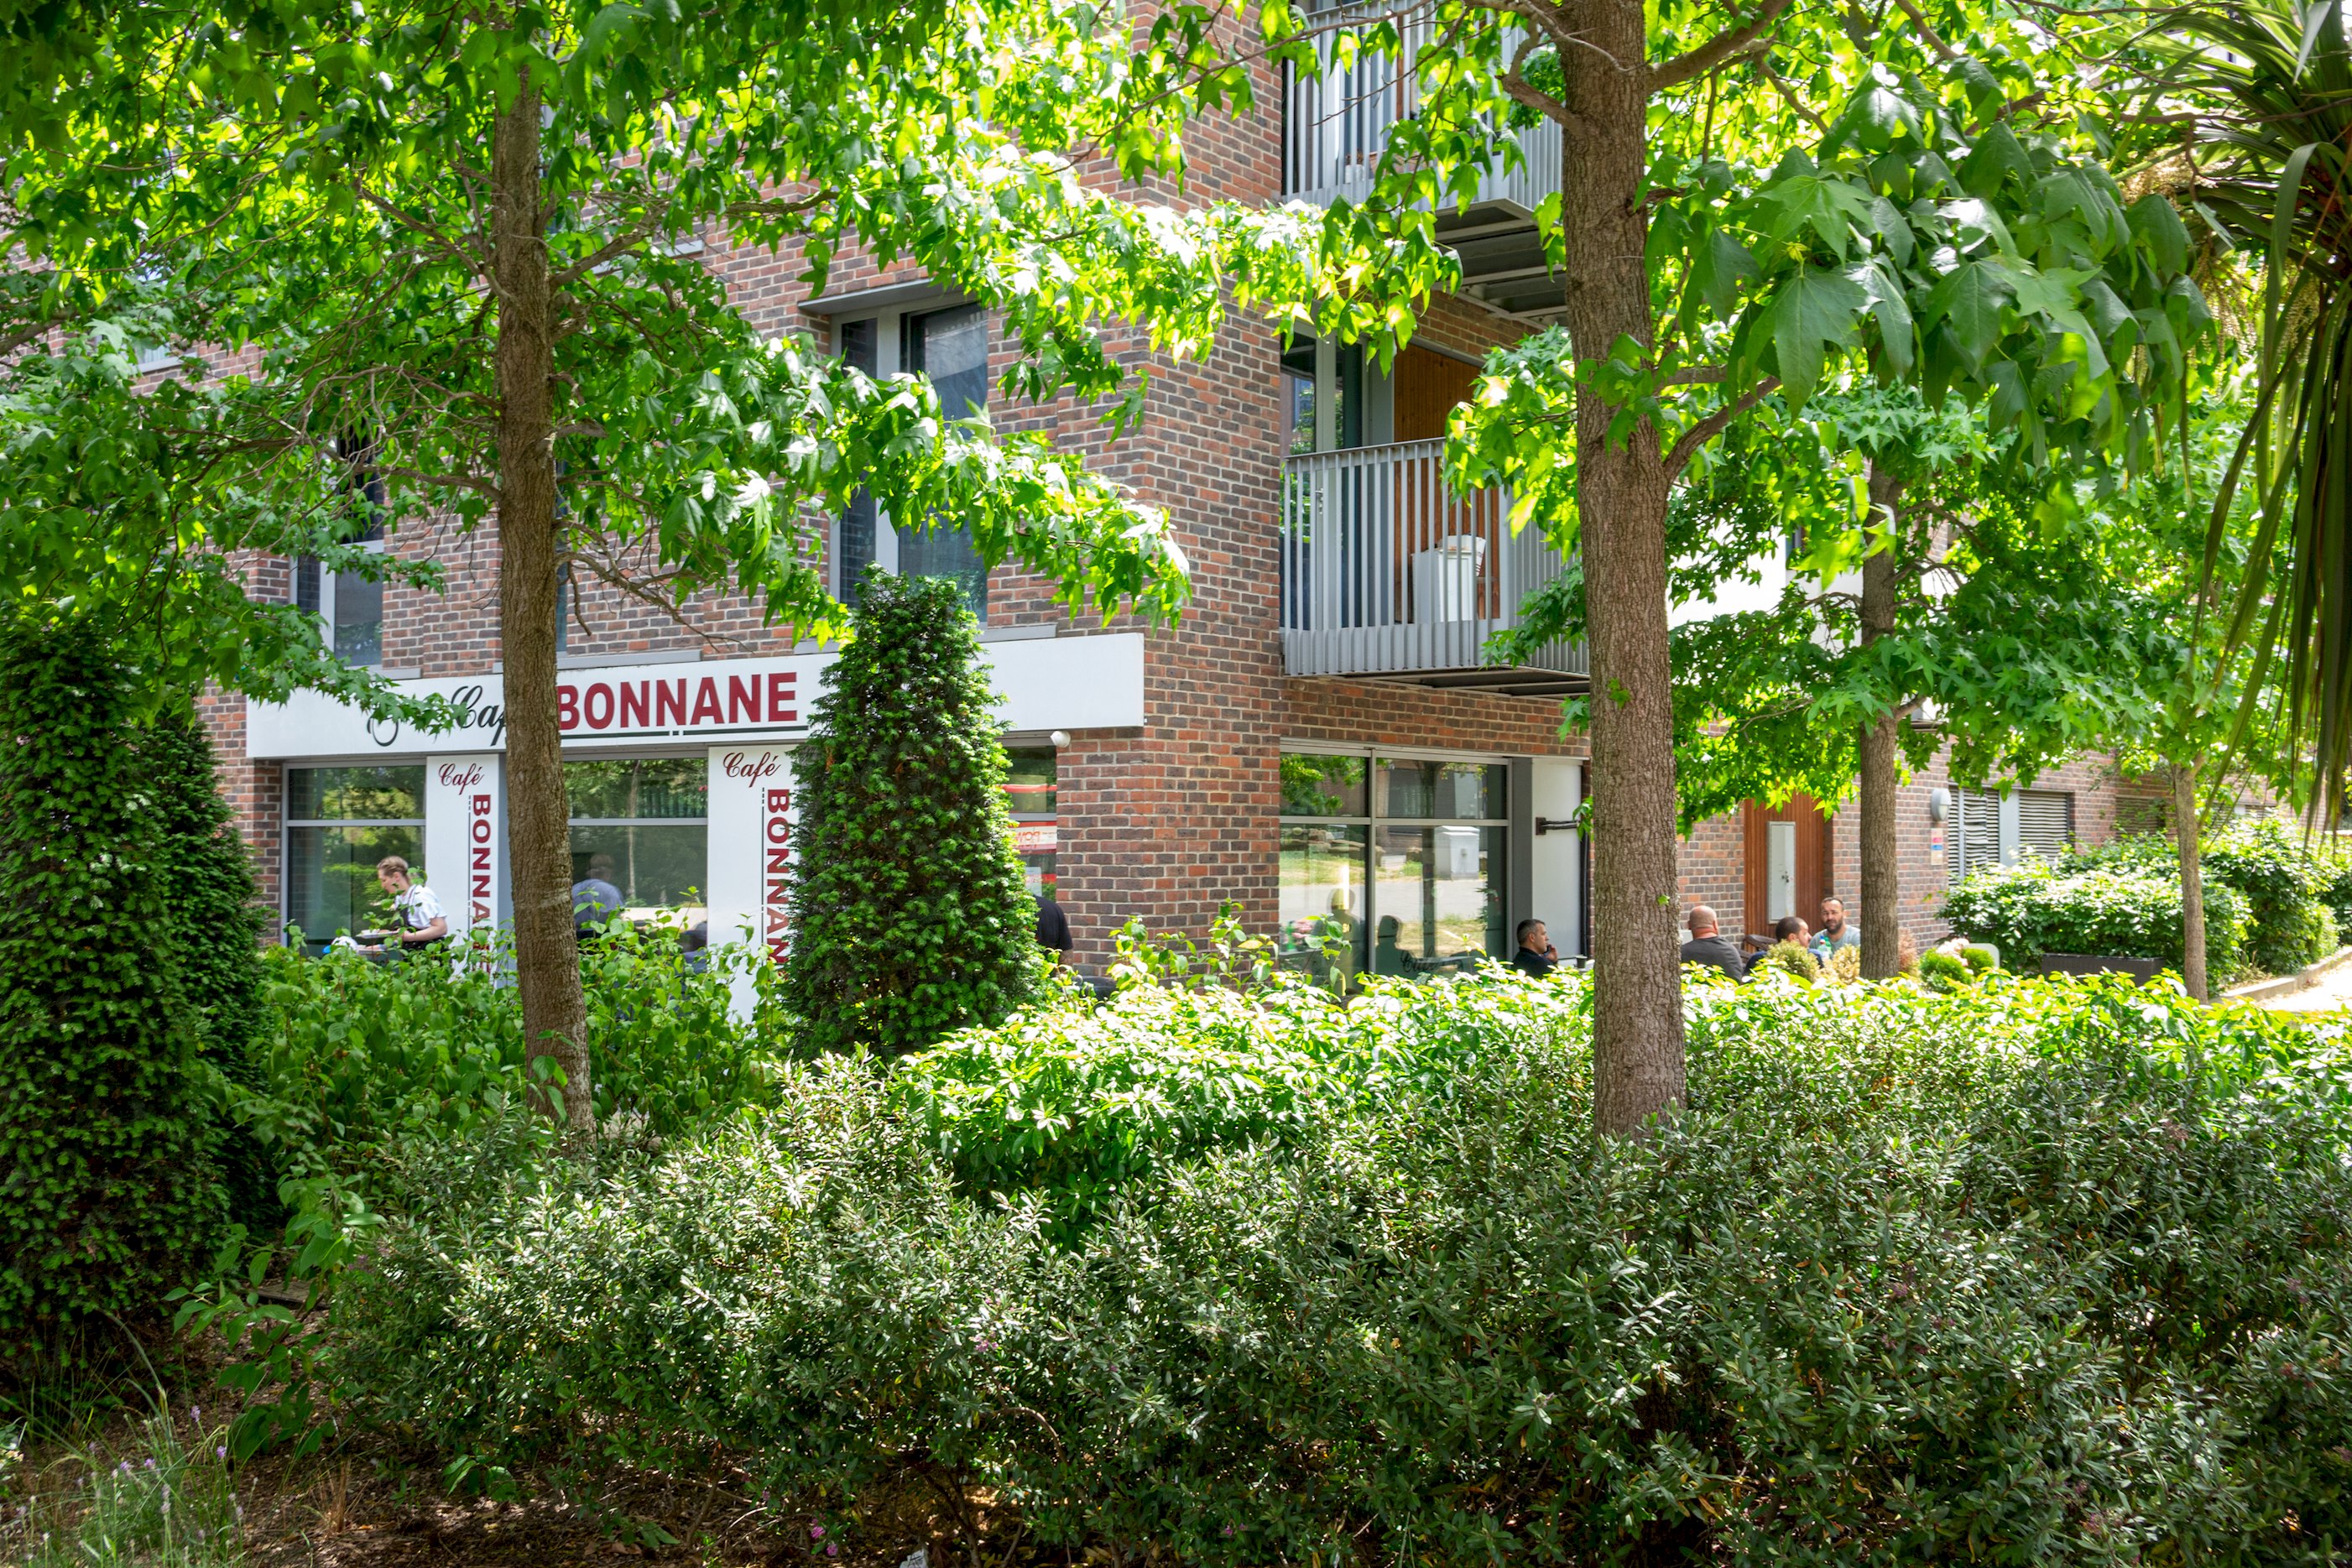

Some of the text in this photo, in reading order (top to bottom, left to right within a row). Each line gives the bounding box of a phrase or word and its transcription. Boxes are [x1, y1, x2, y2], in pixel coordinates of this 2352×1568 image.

[451, 672, 797, 747] Ca BONNANE
[438, 763, 484, 795] Café
[722, 752, 781, 788] Café
[472, 794, 491, 976] BONNA
[767, 789, 790, 982] BONNAN
